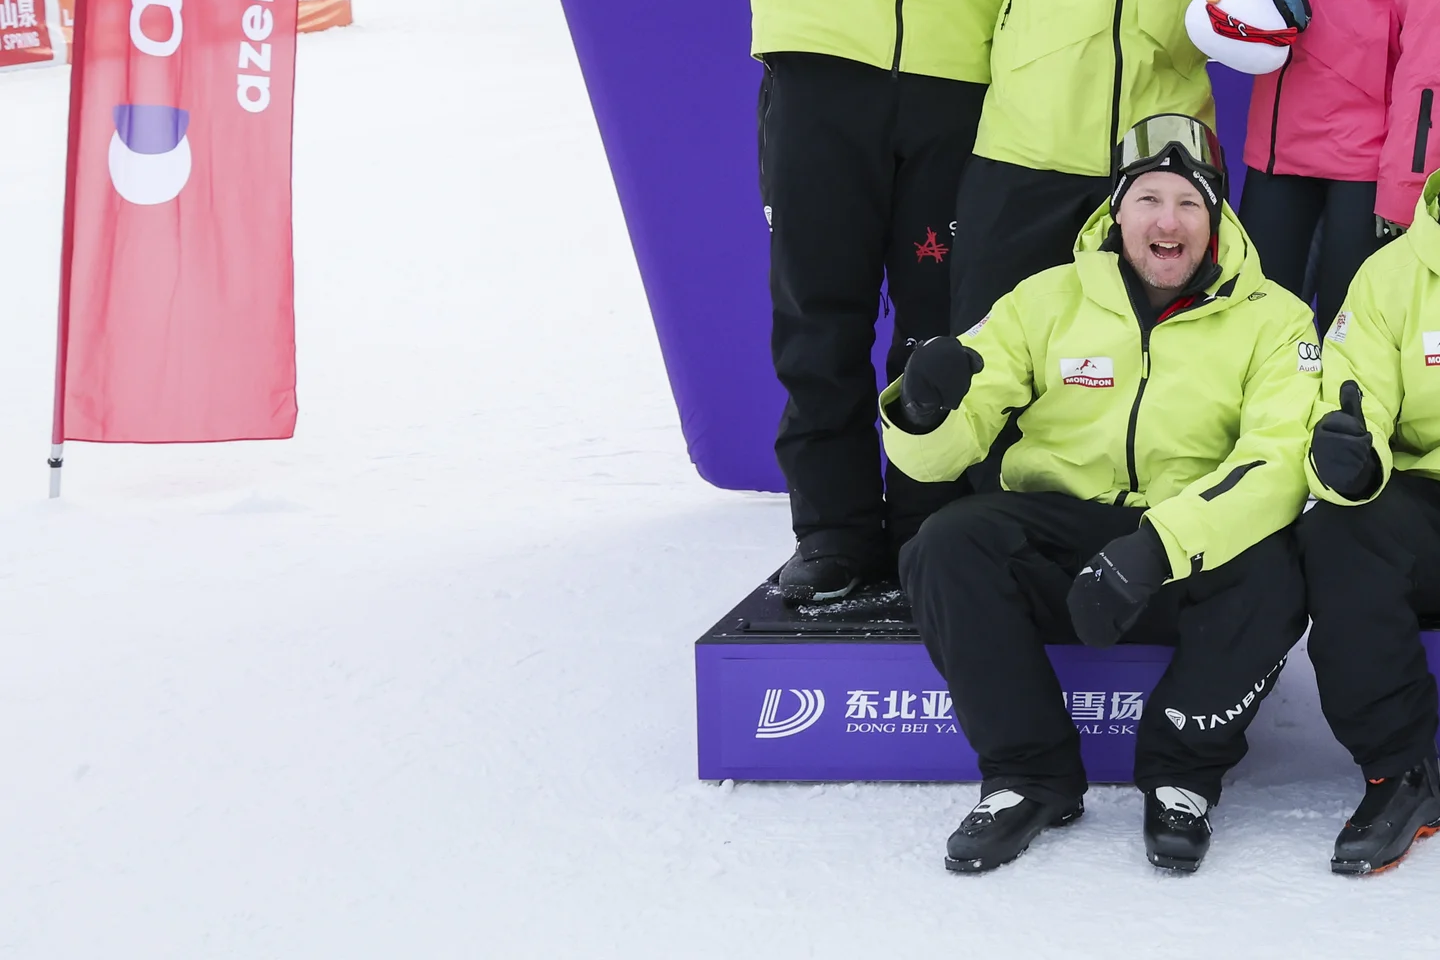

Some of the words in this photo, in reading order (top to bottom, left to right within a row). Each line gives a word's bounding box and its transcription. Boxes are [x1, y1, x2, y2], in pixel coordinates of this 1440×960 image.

[1299, 364, 1319, 372] Audi
[1066, 376, 1112, 388] MONTAFON
[846, 723, 896, 734] DONG
[901, 723, 928, 734] BEI
[934, 723, 958, 734] YA
